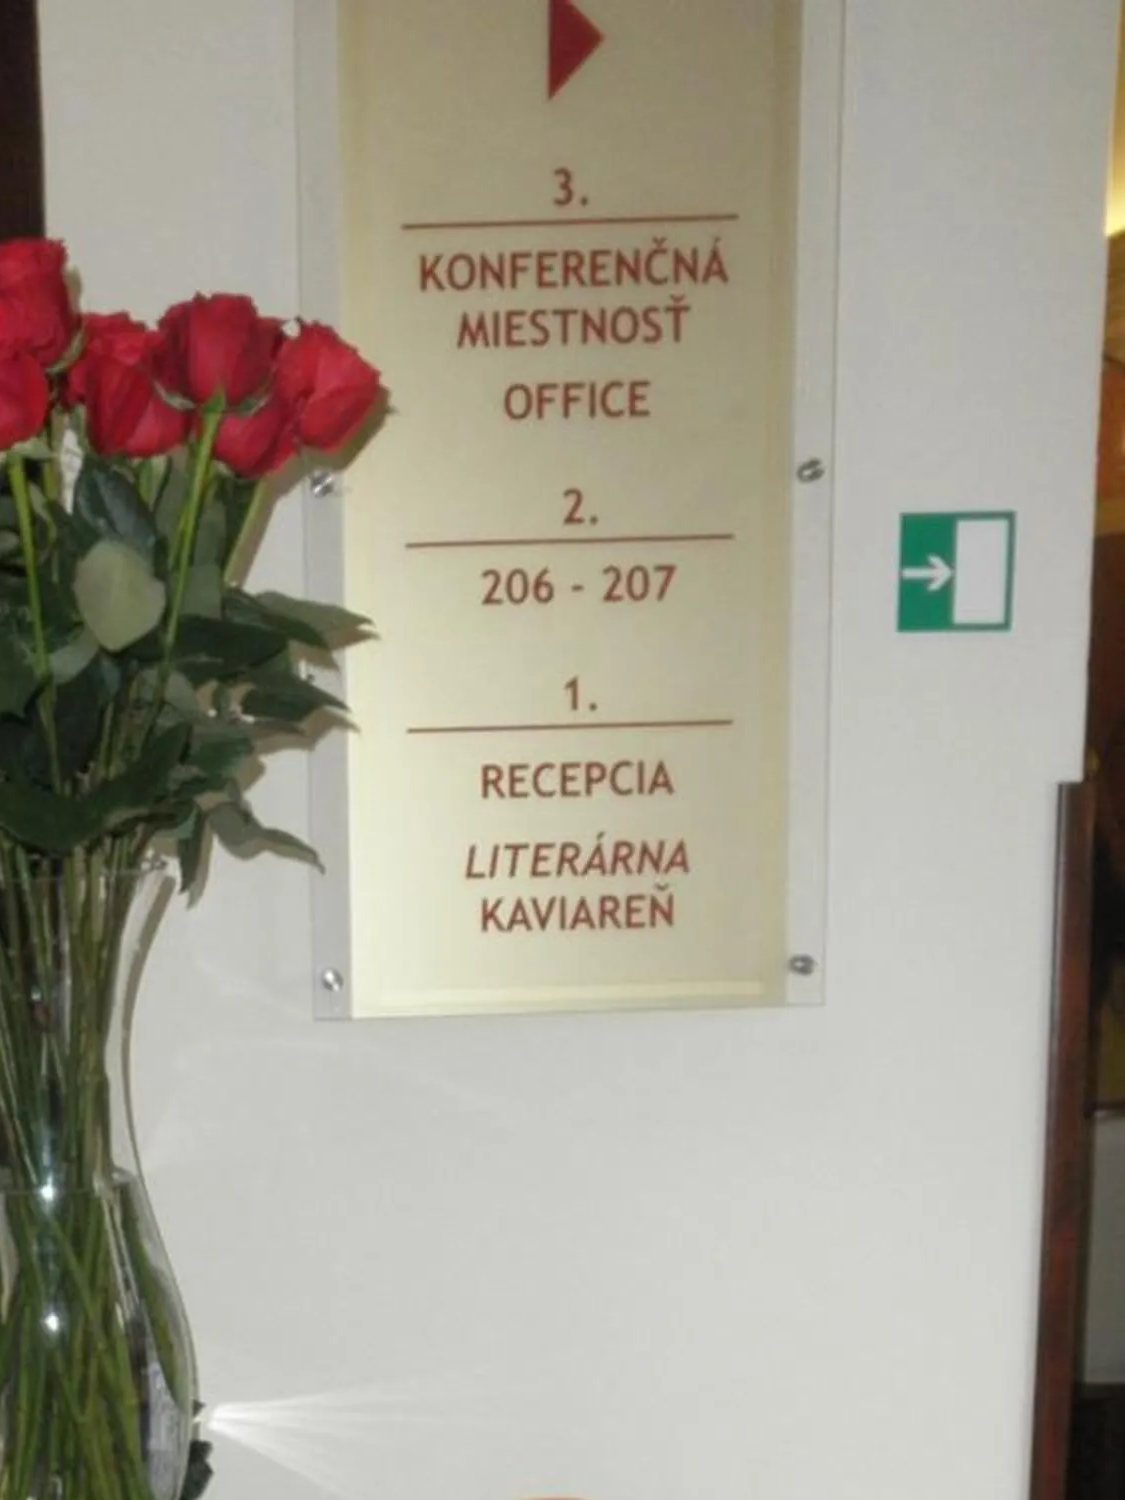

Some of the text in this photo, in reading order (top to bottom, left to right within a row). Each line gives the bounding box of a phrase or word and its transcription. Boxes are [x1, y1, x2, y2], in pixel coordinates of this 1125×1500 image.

[553, 167, 590, 207] 3.
[419, 237, 729, 292] KONFERENČNÁ
[456, 295, 691, 349] MIESTNOSŤ
[503, 379, 652, 421] OFFICE
[562, 487, 599, 526] 2.
[481, 567, 556, 606] 206
[602, 563, 677, 604] 207
[564, 676, 598, 712] 1.
[480, 759, 675, 800] RECEPCIA
[464, 831, 690, 880] LITERÁRNA
[480, 883, 675, 933] KAVIAREŇ
